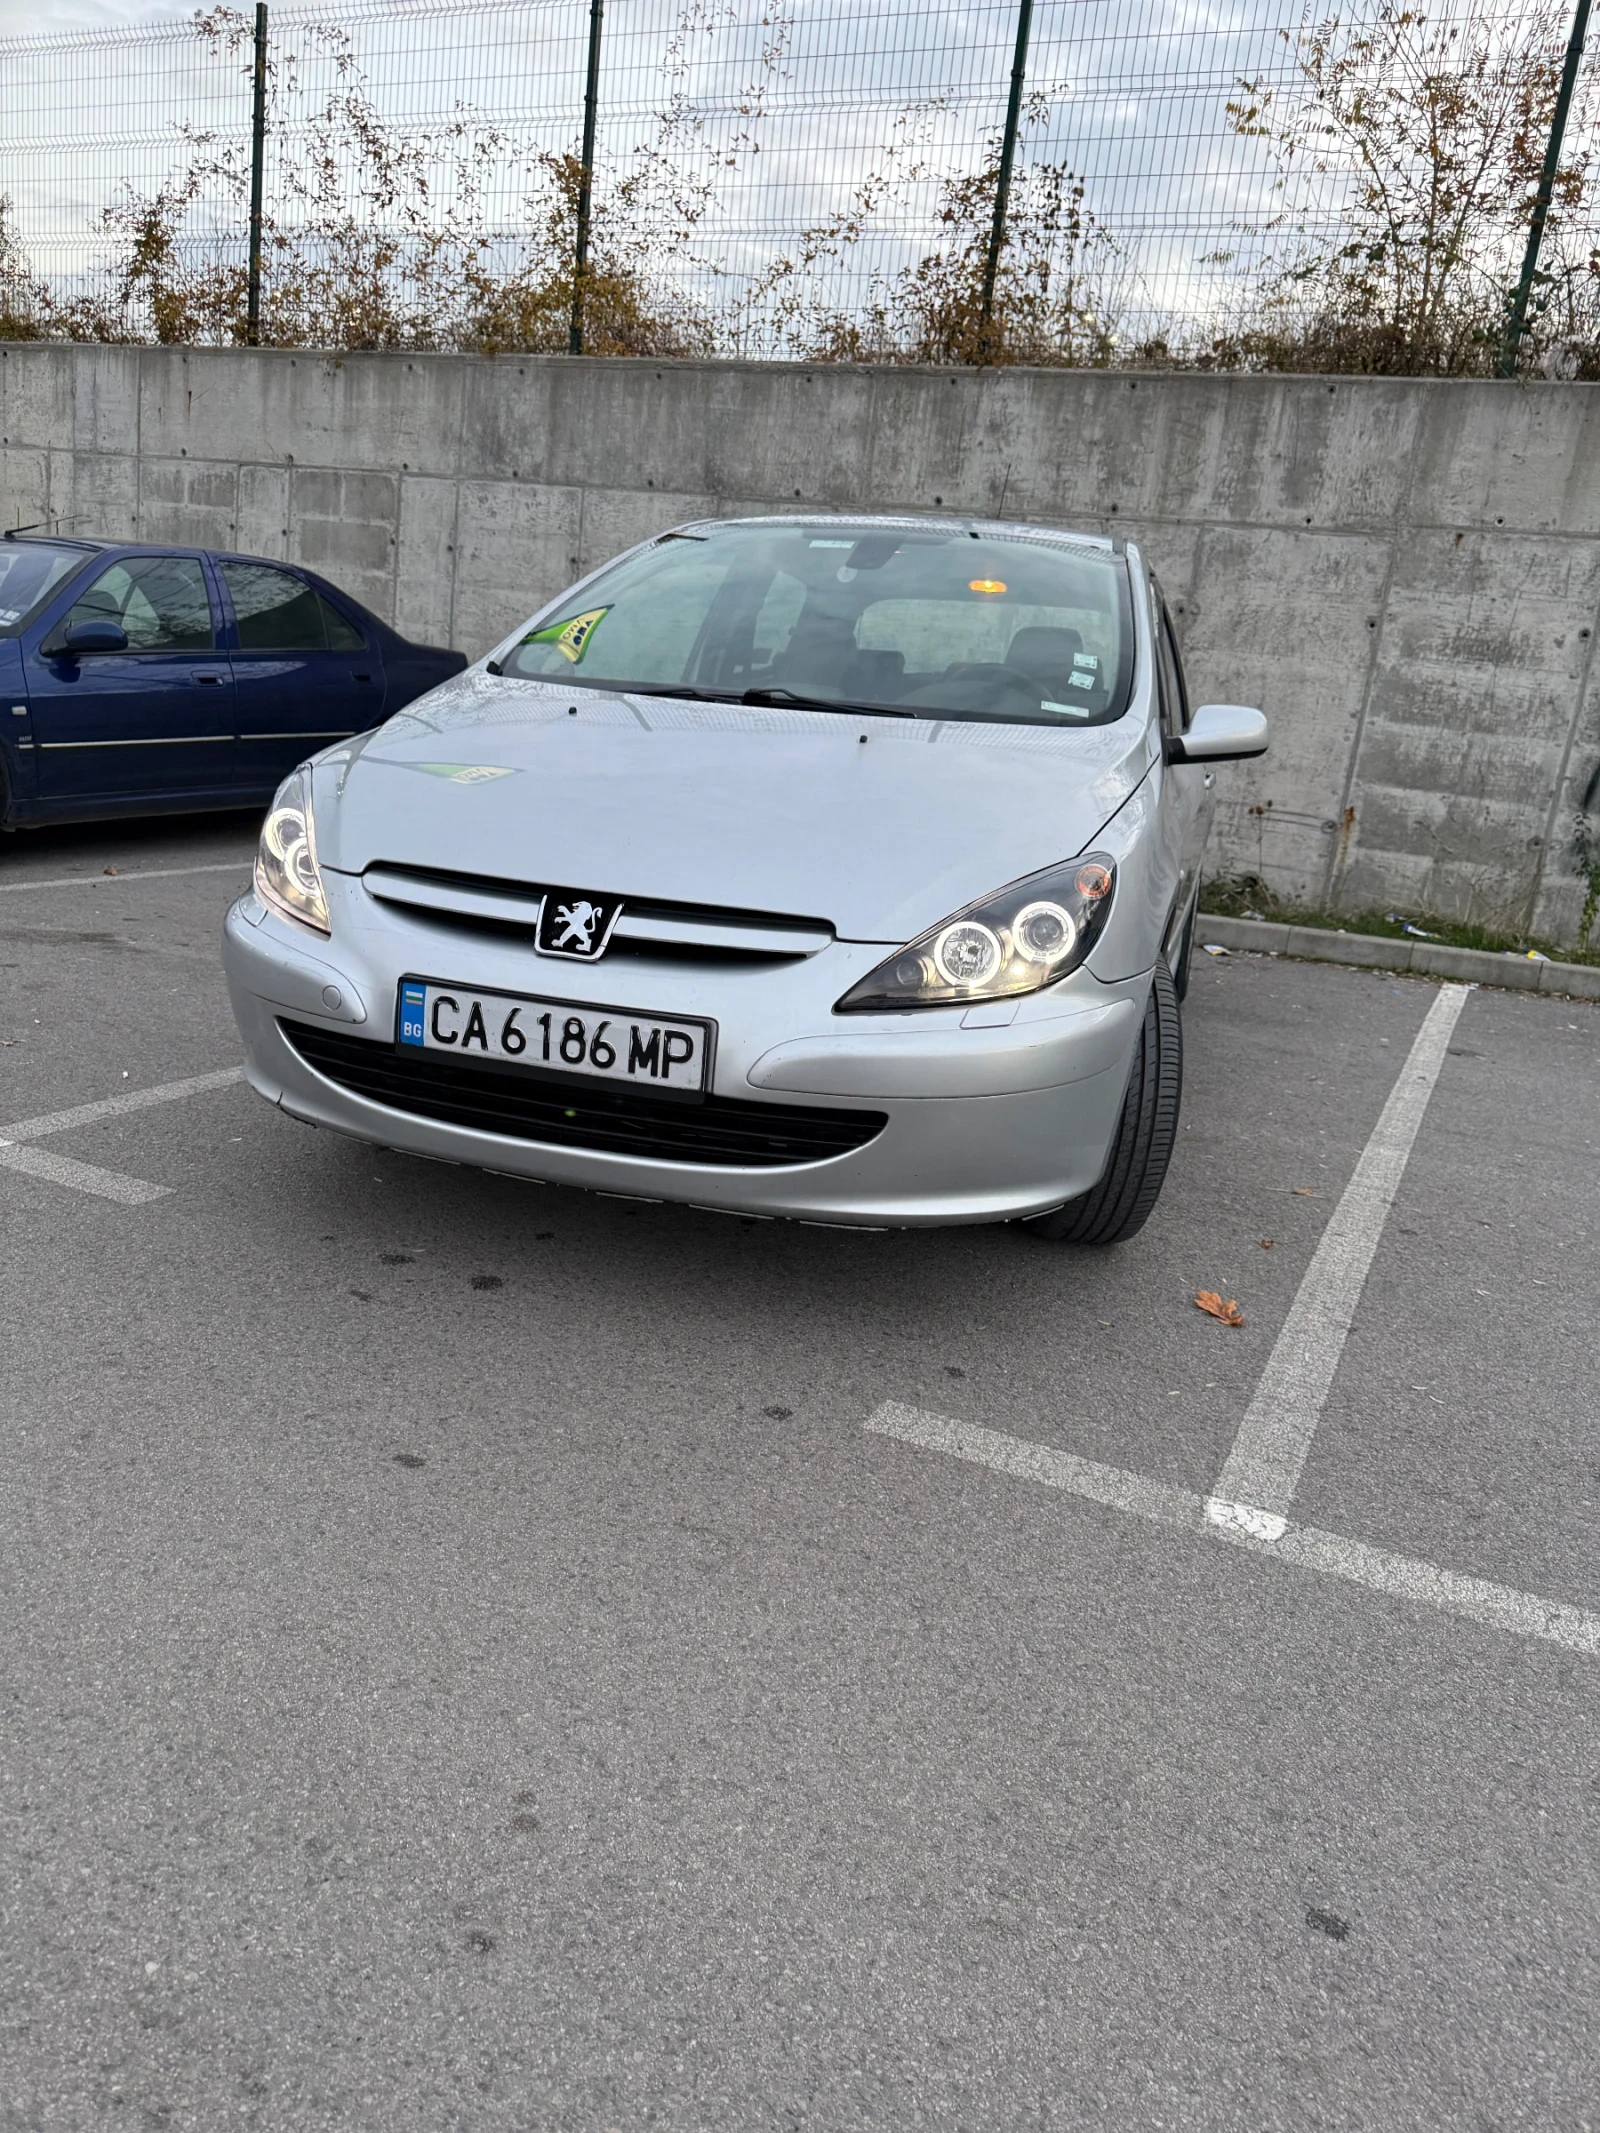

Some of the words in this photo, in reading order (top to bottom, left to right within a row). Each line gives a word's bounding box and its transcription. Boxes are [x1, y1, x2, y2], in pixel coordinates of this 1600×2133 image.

[403, 1021, 422, 1038] BG
[431, 996, 489, 1051] CA
[501, 1007, 617, 1069] 6186
[628, 1024, 694, 1079] MP
